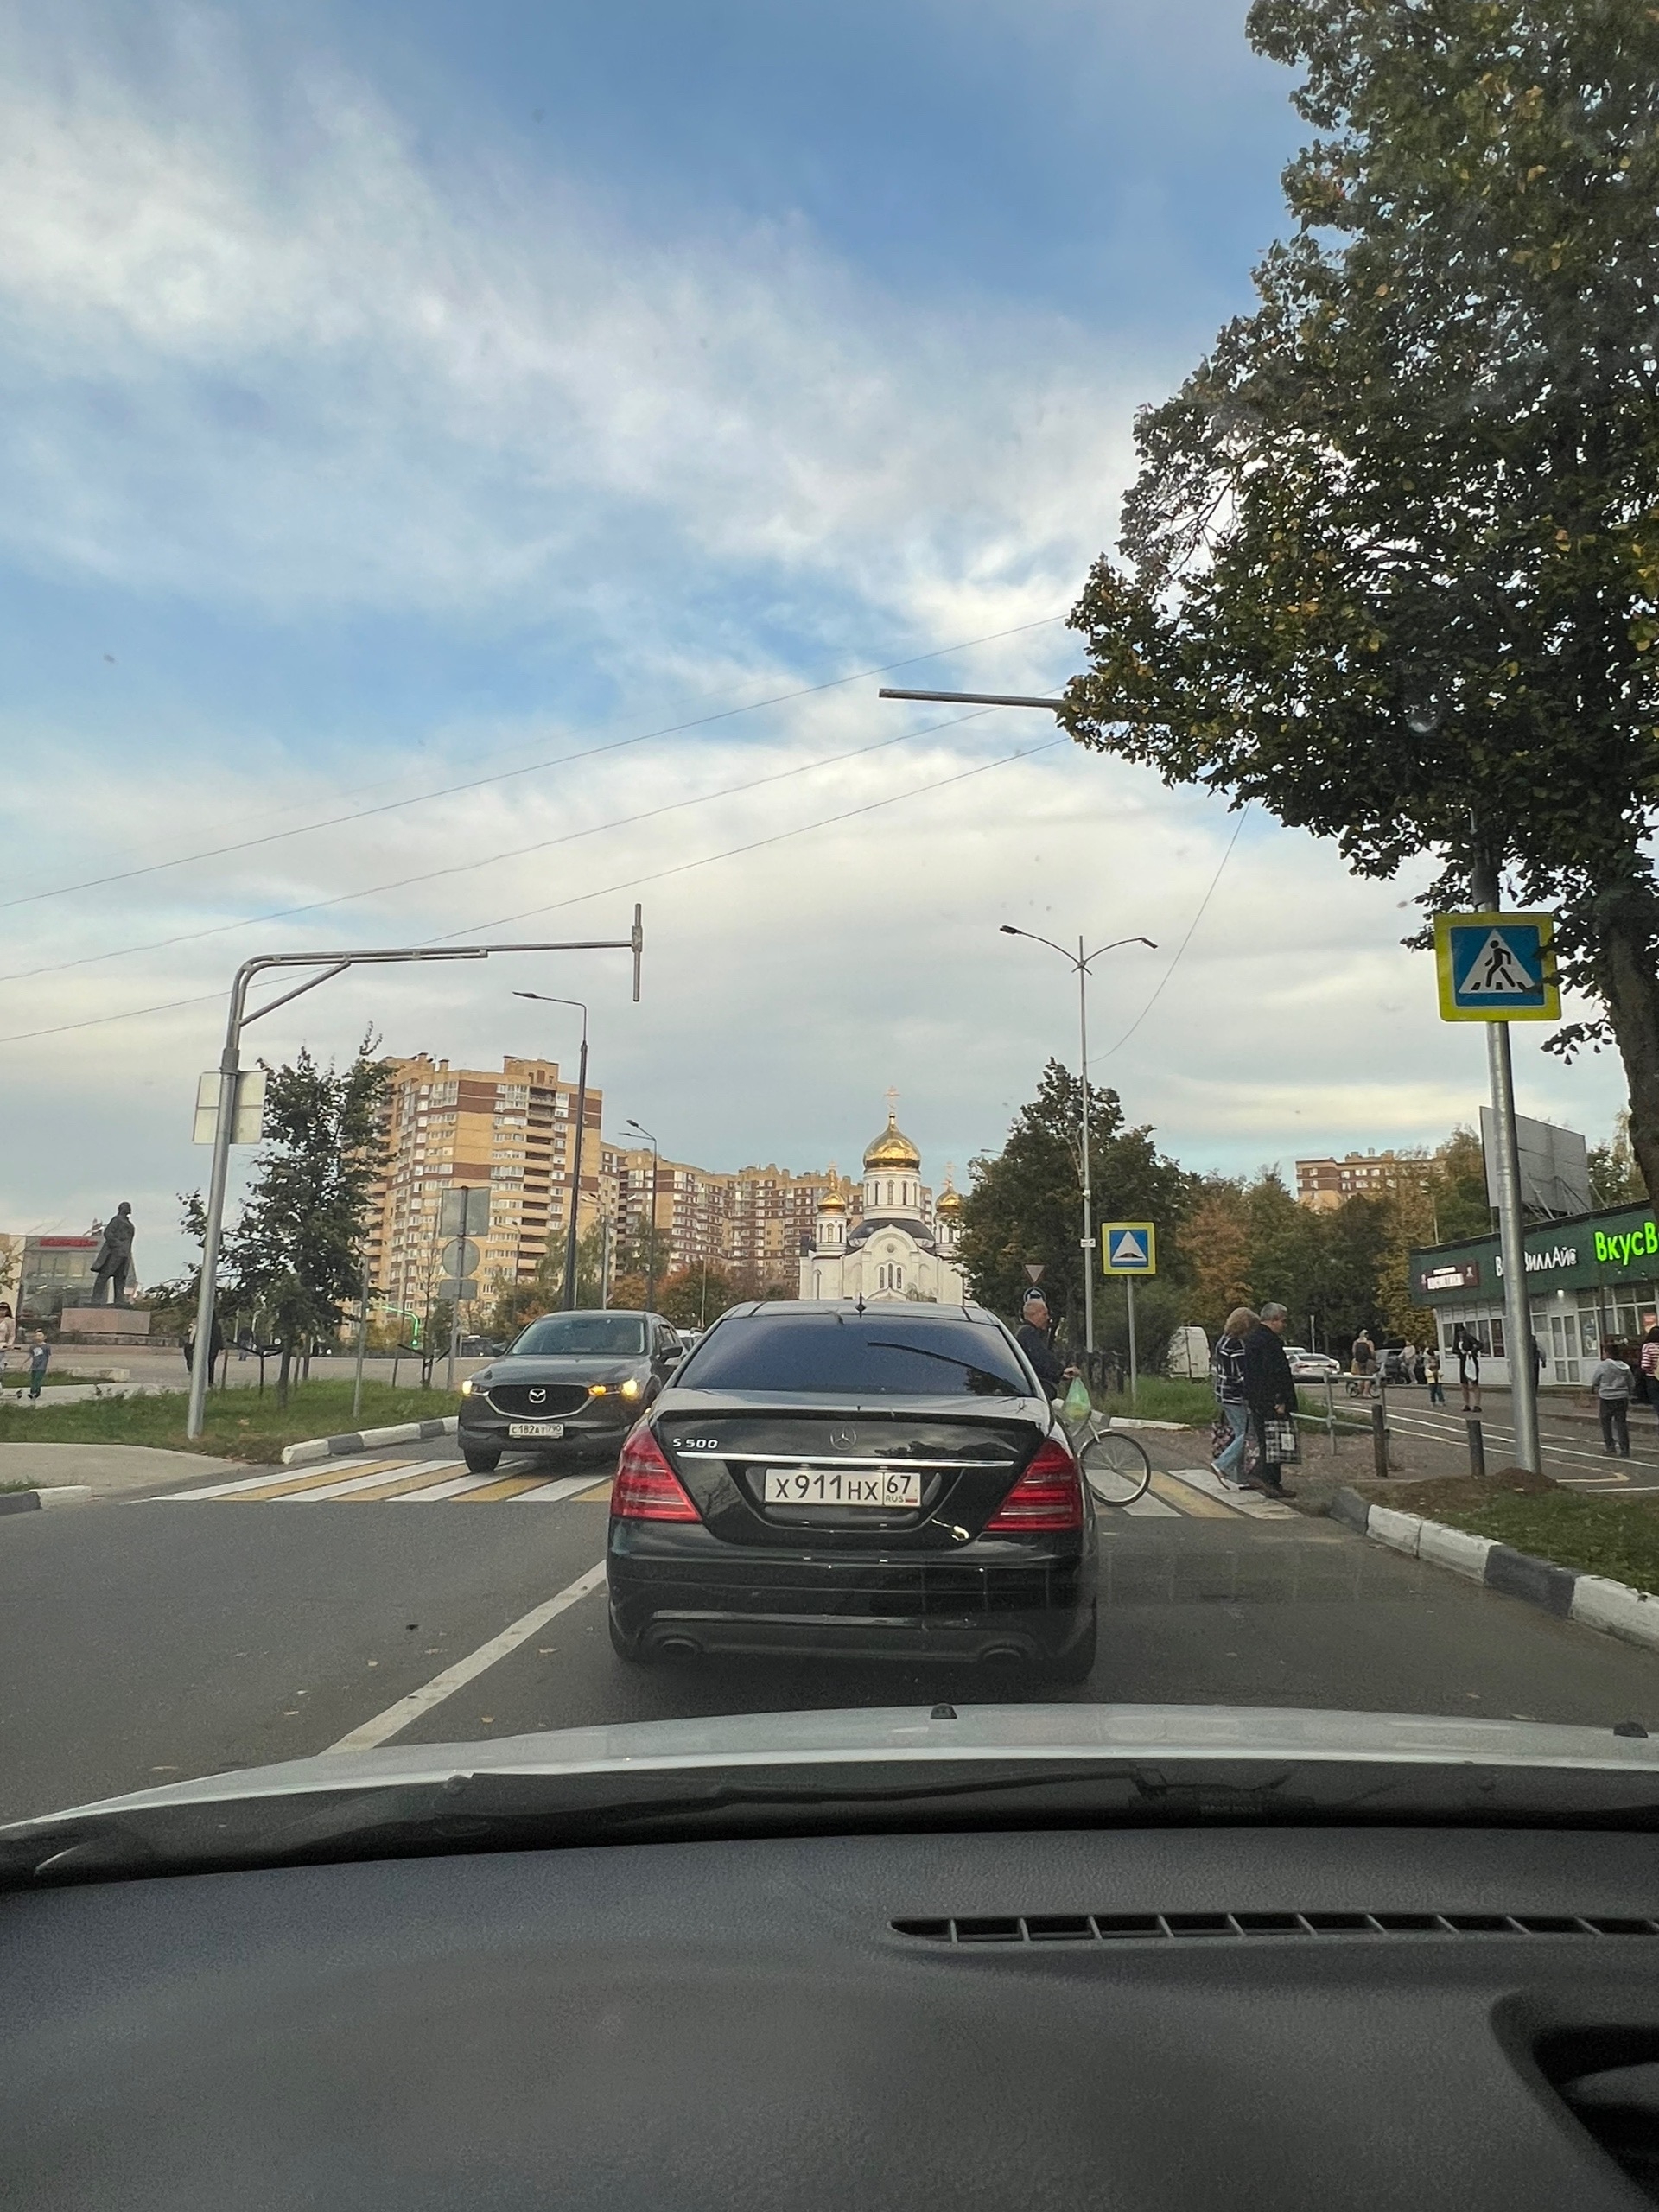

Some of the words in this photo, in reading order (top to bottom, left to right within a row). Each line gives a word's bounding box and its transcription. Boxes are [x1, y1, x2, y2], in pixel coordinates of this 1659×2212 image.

[1595, 1221, 1659, 1265] ВкусВ
[673, 1438, 682, 1447] S
[686, 1439, 718, 1448] 500
[885, 1495, 904, 1503] RUS
